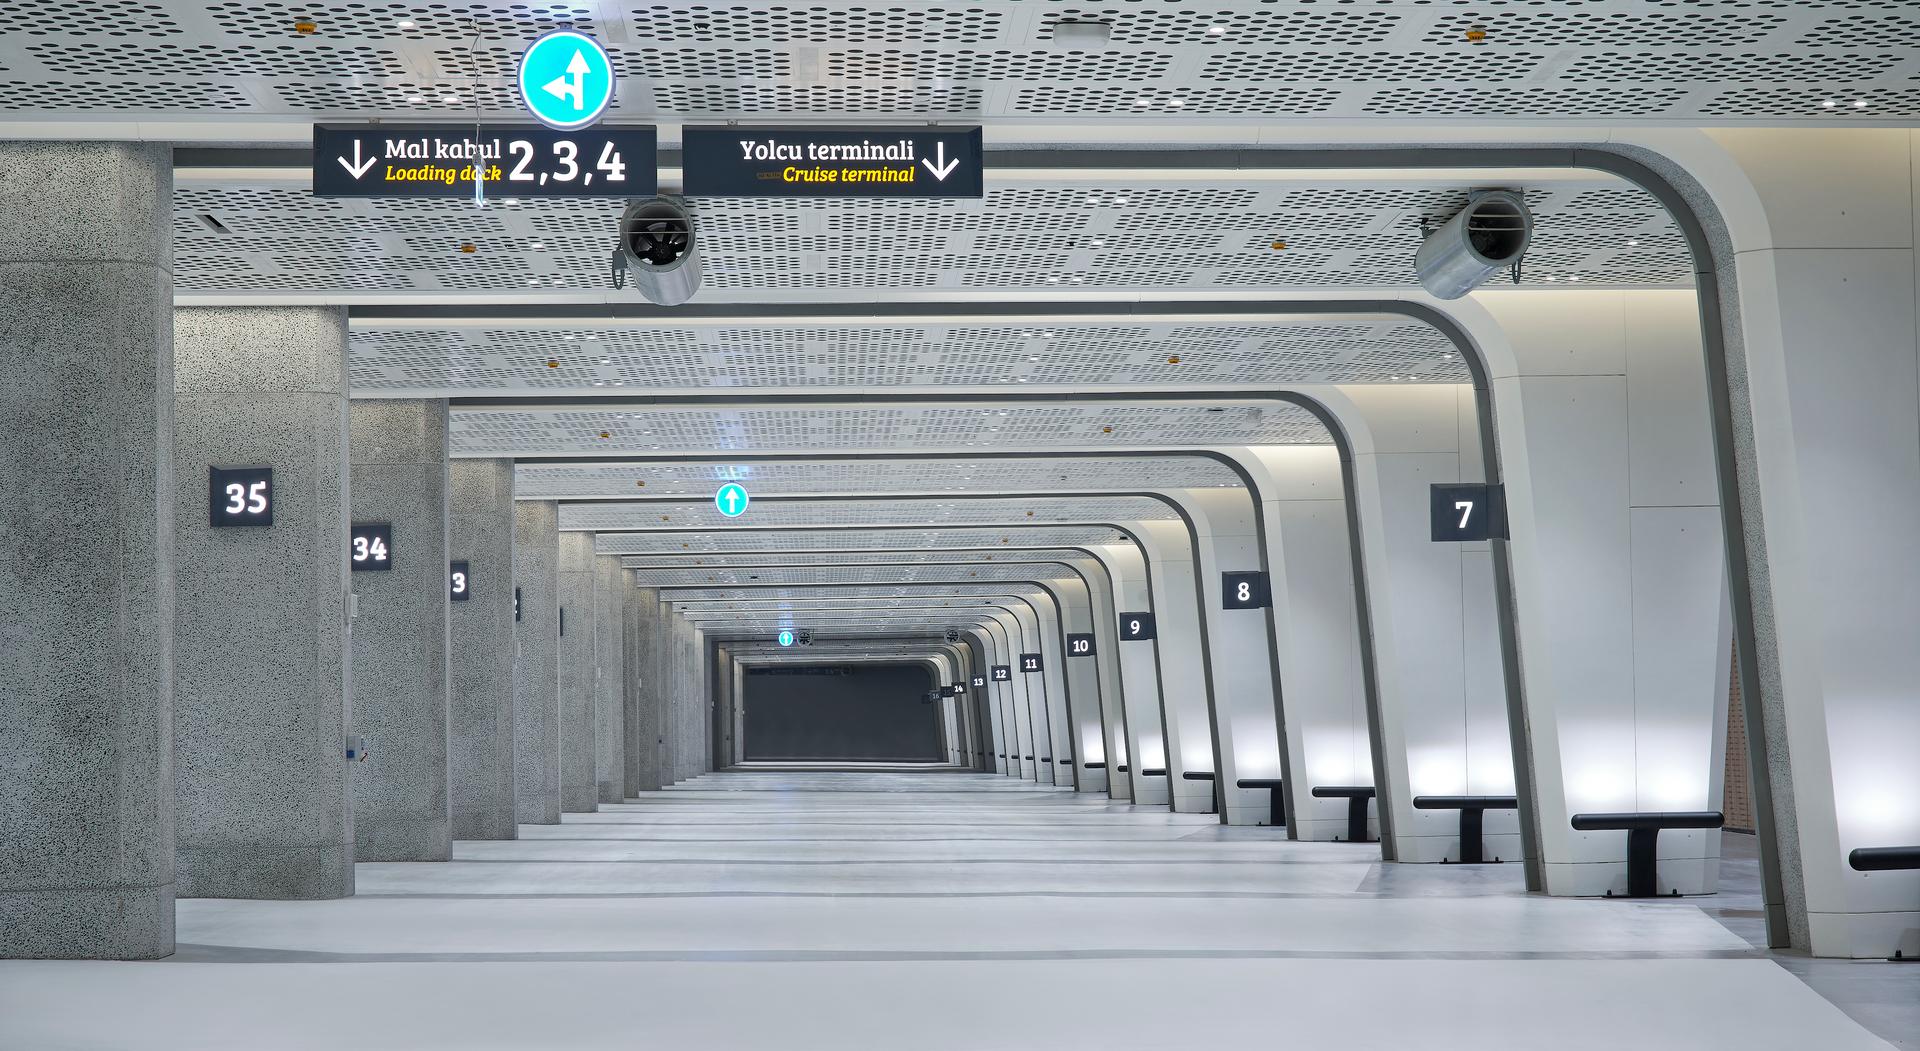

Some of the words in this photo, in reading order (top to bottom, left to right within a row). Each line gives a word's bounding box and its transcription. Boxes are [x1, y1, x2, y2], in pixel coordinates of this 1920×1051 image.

[385, 139, 429, 159] Mal
[434, 138, 501, 159] kabul
[740, 140, 803, 161] Yolcu
[808, 140, 914, 161] terminali
[509, 140, 625, 186] 2,3,4
[385, 165, 455, 185] Loading
[783, 167, 838, 182] Cruise
[841, 167, 914, 182] terminal
[225, 480, 267, 514] 35
[1455, 501, 1474, 529] 7
[353, 536, 387, 561] 34
[450, 572, 466, 593] 3
[1237, 582, 1251, 602] 8
[1130, 620, 1141, 635] 9
[1073, 640, 1089, 652] 10
[995, 669, 1007, 679] 12
[1025, 659, 1037, 669] 11
[954, 684, 964, 693] 14
[973, 678, 984, 687] 13
